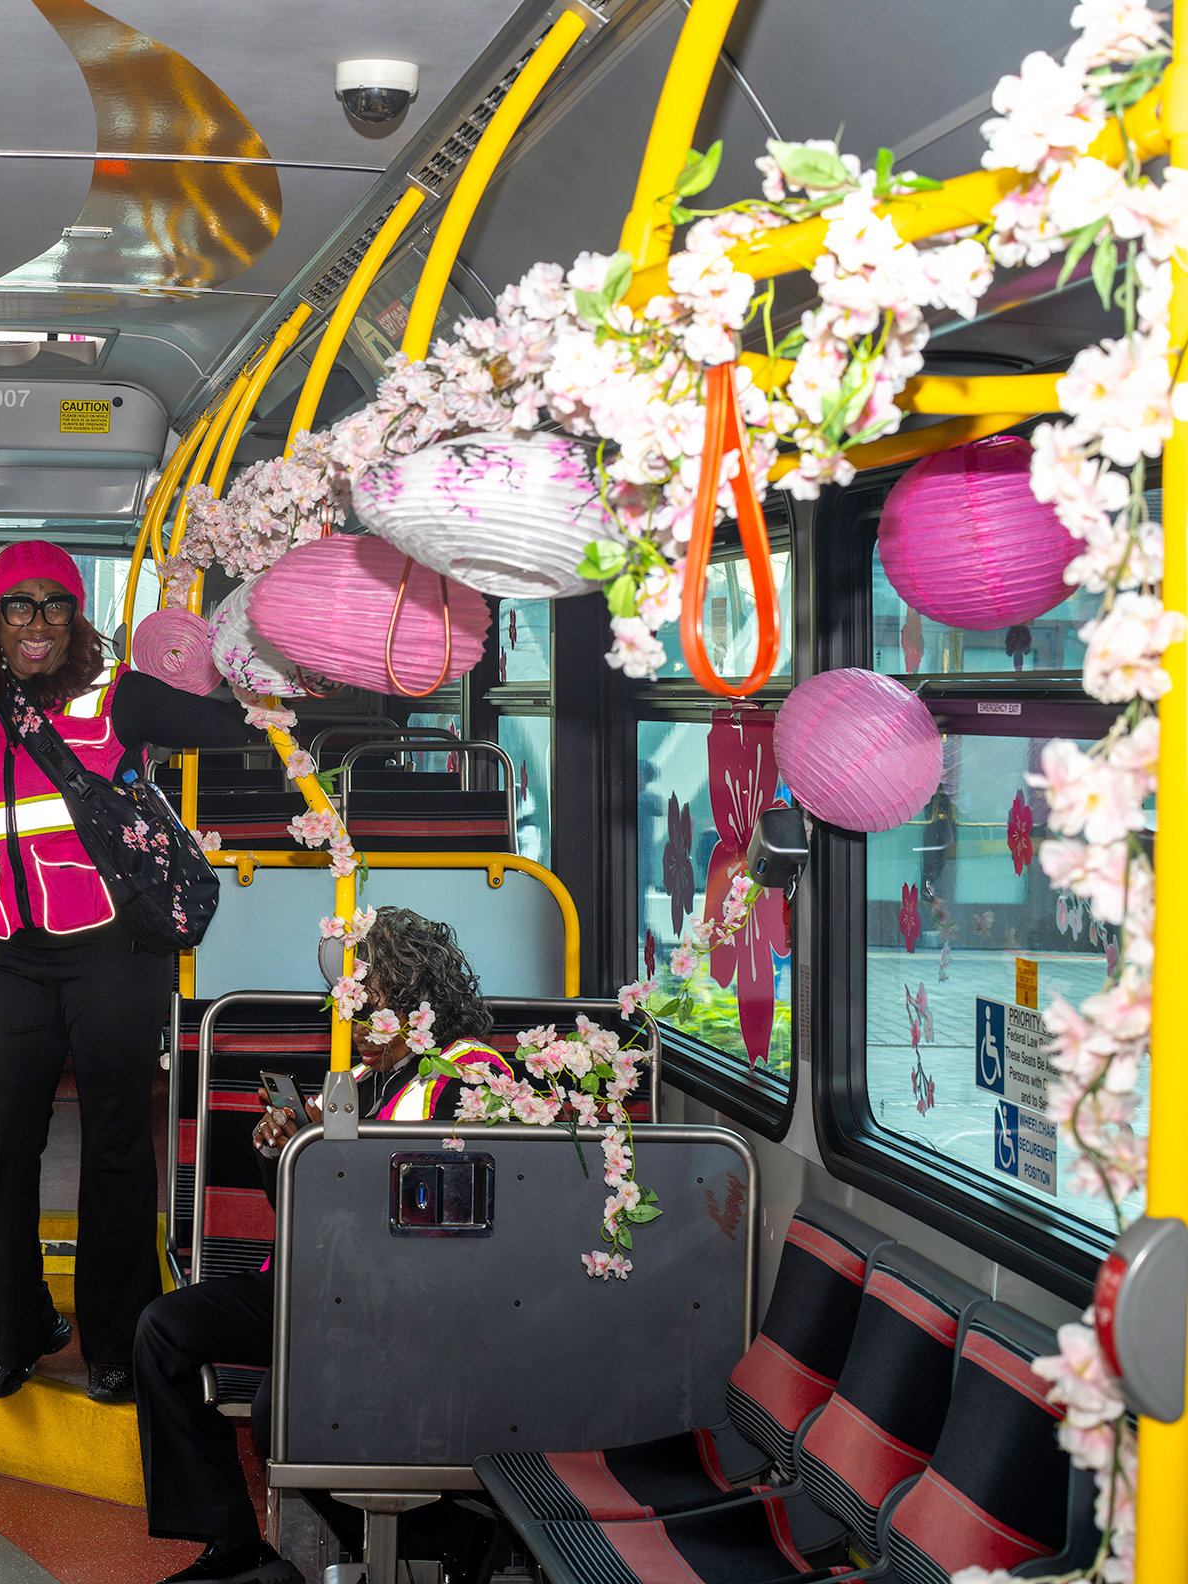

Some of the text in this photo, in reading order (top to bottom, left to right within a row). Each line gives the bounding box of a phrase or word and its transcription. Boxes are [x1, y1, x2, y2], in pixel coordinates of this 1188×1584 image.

[62, 401, 109, 411] CAUTION
[980, 704, 1019, 713] EMERGENCY EXIT
[1009, 1008, 1041, 1031] PRIORITY
[1007, 1027, 1026, 1045] Federal
[1027, 1033, 1038, 1048] Law
[1005, 1045, 1020, 1062] These
[1022, 1051, 1036, 1068] Seats
[1037, 1056, 1044, 1071] Be
[1009, 1066, 1042, 1089] Persons with
[1021, 1092, 1031, 1104] and
[1032, 1094, 1037, 1107] to
[1019, 1113, 1056, 1140] WHEELCHAIR
[1018, 1137, 1056, 1164] SECUREMENT
[1024, 1163, 1050, 1186] POSITION
